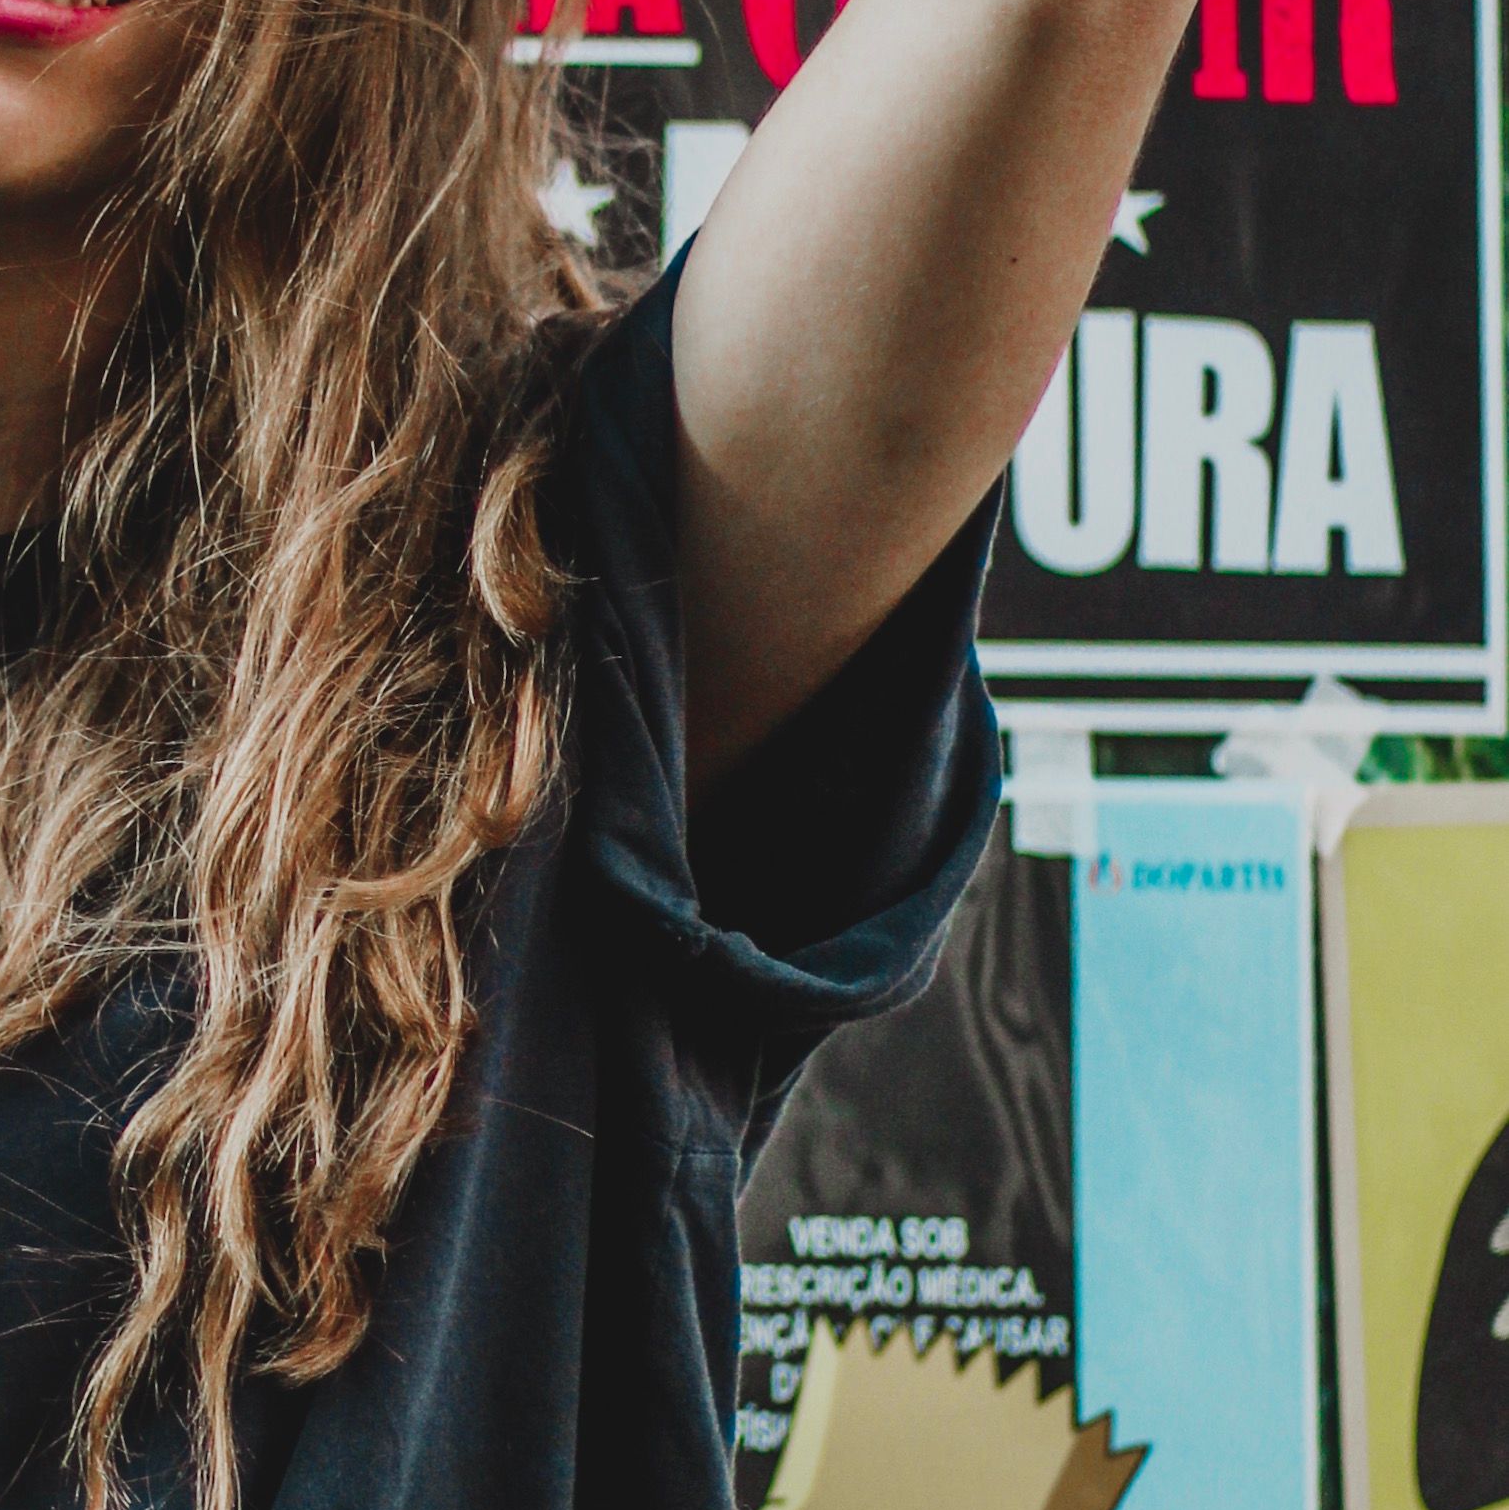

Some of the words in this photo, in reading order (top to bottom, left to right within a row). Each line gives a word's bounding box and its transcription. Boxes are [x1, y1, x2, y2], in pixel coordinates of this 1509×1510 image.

[788, 1215, 897, 1259] VENDA
[899, 1215, 970, 1260] SOB
[740, 1258, 914, 1313] RESCRIÇÃO
